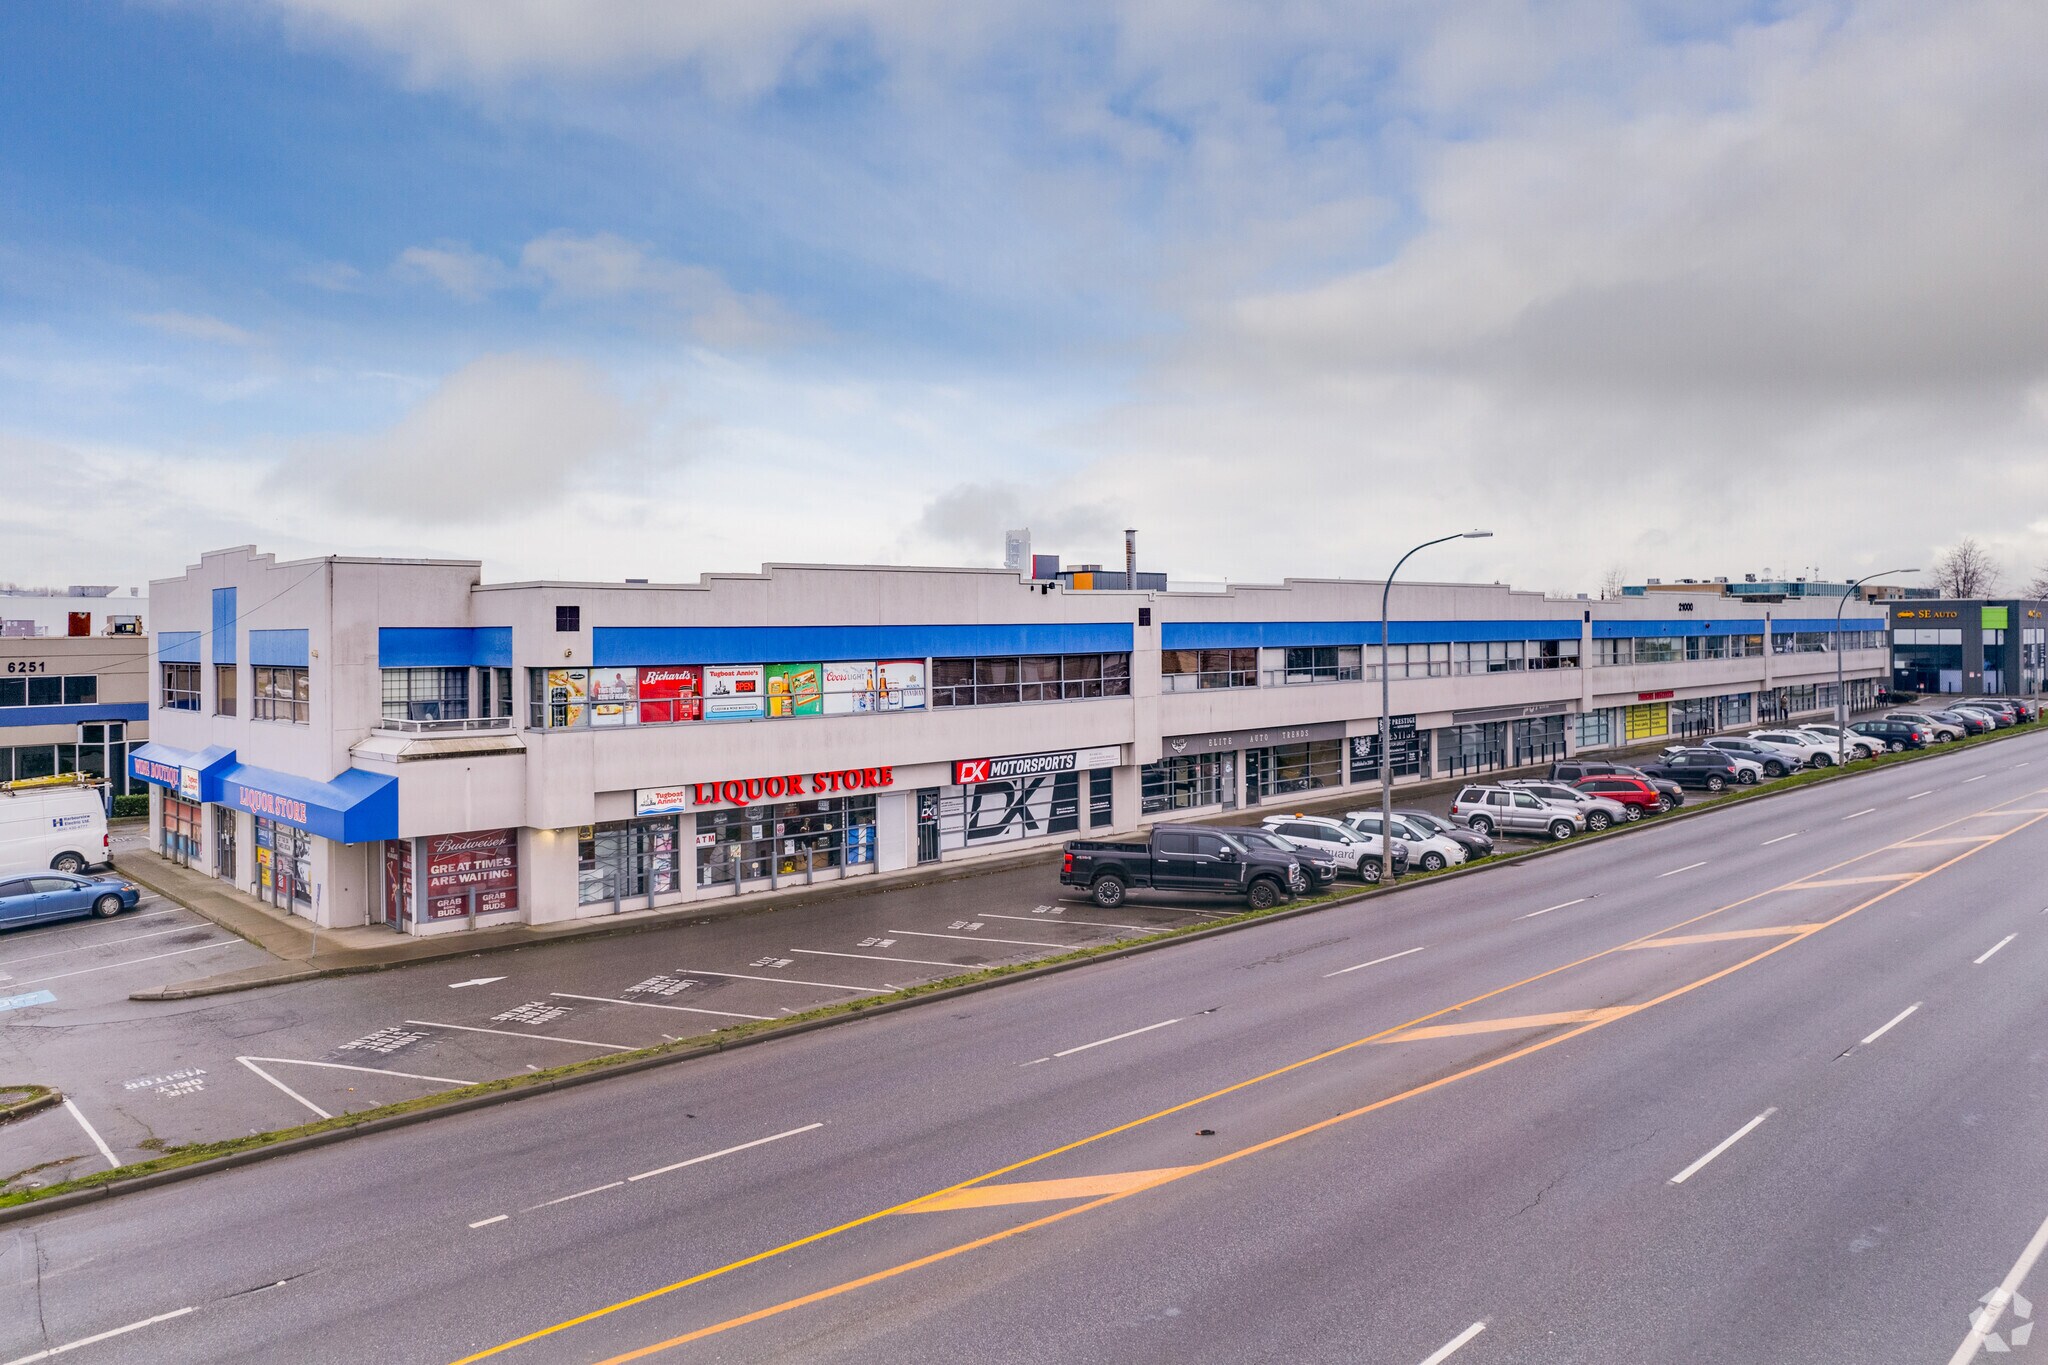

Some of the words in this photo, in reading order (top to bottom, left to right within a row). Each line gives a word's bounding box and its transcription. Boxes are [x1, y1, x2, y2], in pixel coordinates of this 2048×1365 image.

[1679, 602, 1693, 611] 21000
[1918, 610, 1931, 618] SE
[8, 662, 45, 673] 6251
[642, 670, 691, 684] Rickard's
[826, 671, 847, 682] Coors
[847, 673, 865, 681] LIGHT
[736, 681, 754, 691] OPEN
[1392, 717, 1415, 725] PRESTIGE
[1208, 737, 1233, 747] ELITE
[1250, 733, 1269, 743] AUTO
[1282, 730, 1309, 739] TRENDS
[990, 754, 1074, 776] MOTORSPORTS
[151, 762, 180, 789] BOUTIQU
[693, 774, 806, 806] LIQUOR
[812, 765, 894, 793] STORE
[656, 791, 684, 799] Tugboat
[239, 786, 275, 814] LIQUOR
[275, 795, 307, 824] STORE
[434, 836, 507, 853] Budweiser
[696, 834, 715, 844] ATM
[430, 861, 471, 875] GREAT
[474, 857, 511, 870] TIMES
[431, 875, 456, 887] ARE
[458, 869, 512, 883] WAITING.
[437, 897, 461, 907] GRAB
[482, 892, 506, 901] GRAB
[437, 907, 461, 917] BUDS
[483, 902, 505, 911] BUDS
[124, 1066, 207, 1090] VISITOR
